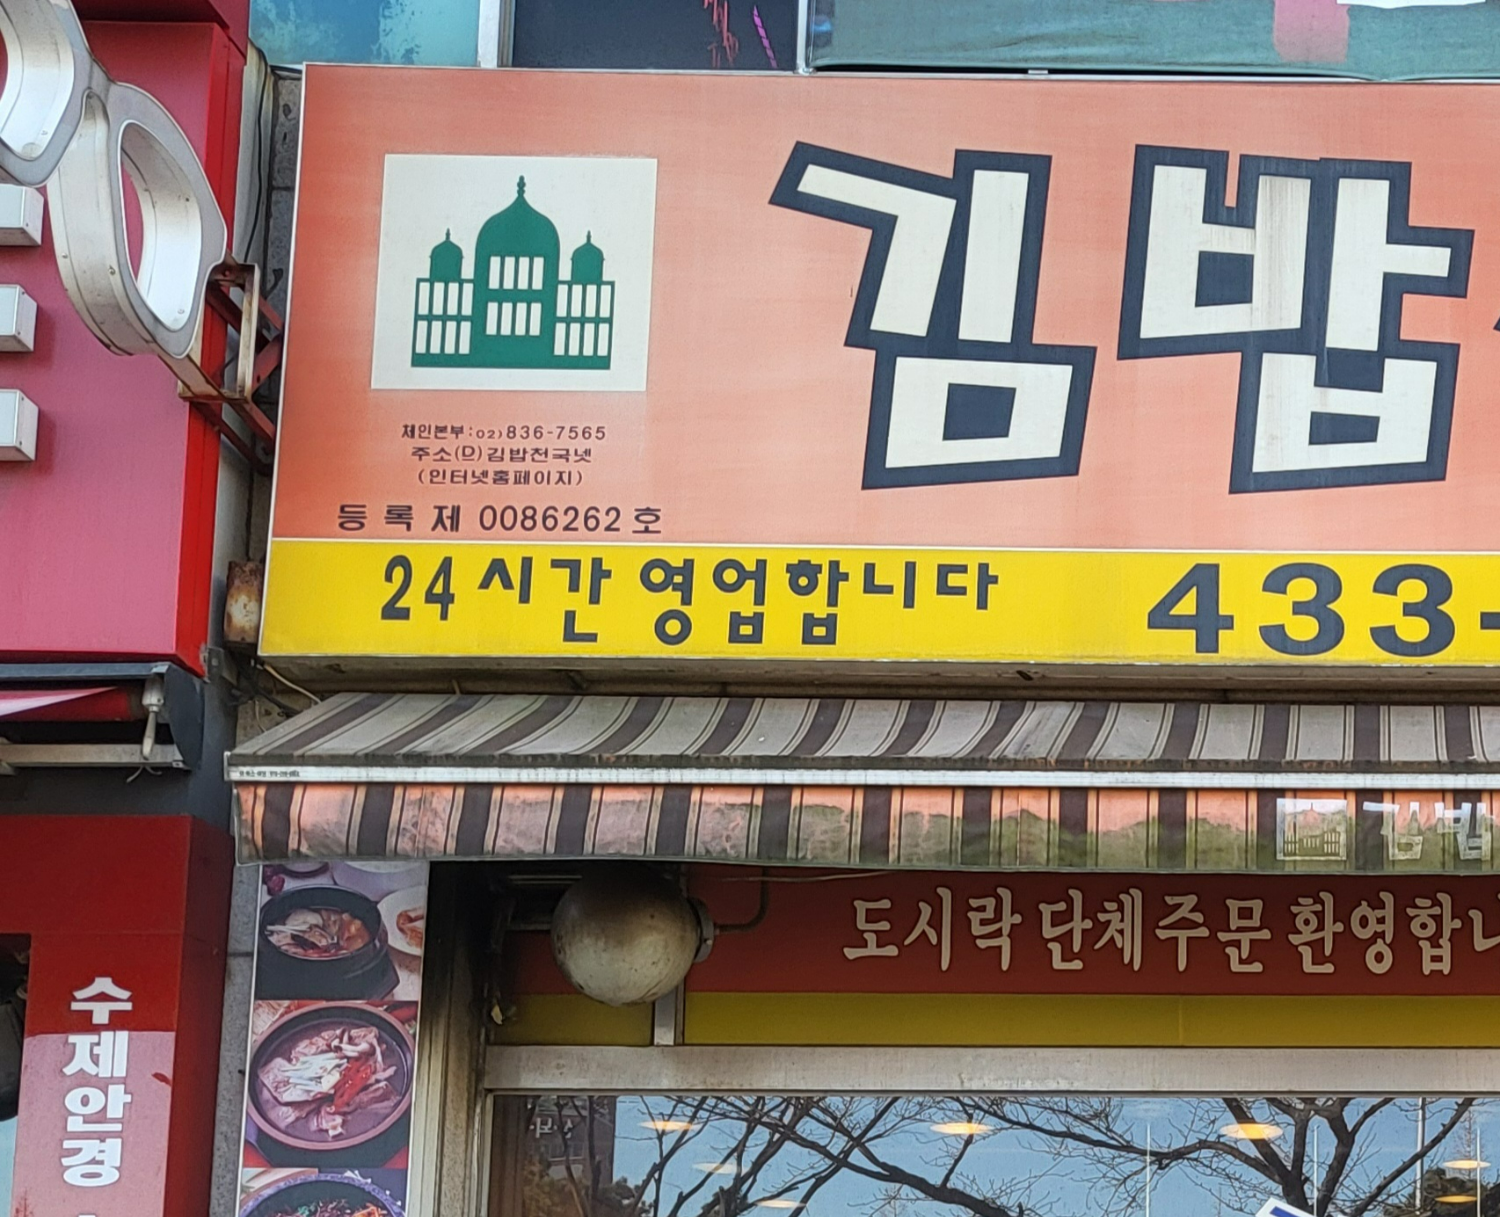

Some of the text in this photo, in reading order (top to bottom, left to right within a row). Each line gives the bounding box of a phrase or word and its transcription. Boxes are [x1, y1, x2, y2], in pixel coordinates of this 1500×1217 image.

[417, 469, 583, 486] (인터넷홈페이지)
[479, 504, 621, 532] 0086262
[631, 506, 662, 534] 호
[380, 555, 999, 647] 24시간 영업합니다
[843, 887, 1022, 972] 도시락
[60, 976, 133, 1188] 수제안경
